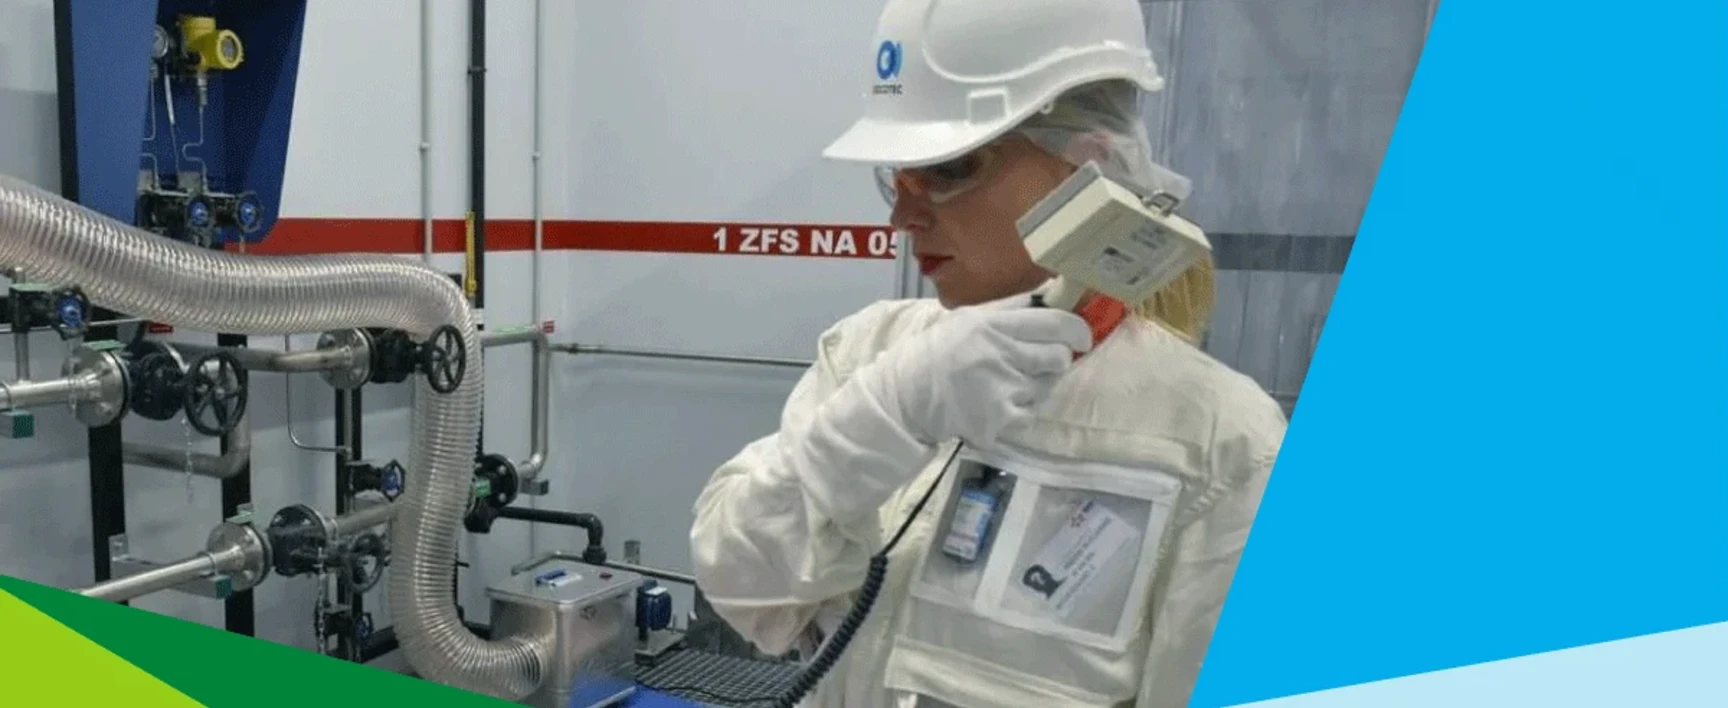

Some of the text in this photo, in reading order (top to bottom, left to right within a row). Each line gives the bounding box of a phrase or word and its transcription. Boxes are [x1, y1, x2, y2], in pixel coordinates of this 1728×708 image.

[713, 227, 727, 251] 1
[739, 228, 800, 253] ZFS
[810, 230, 857, 254] NA
